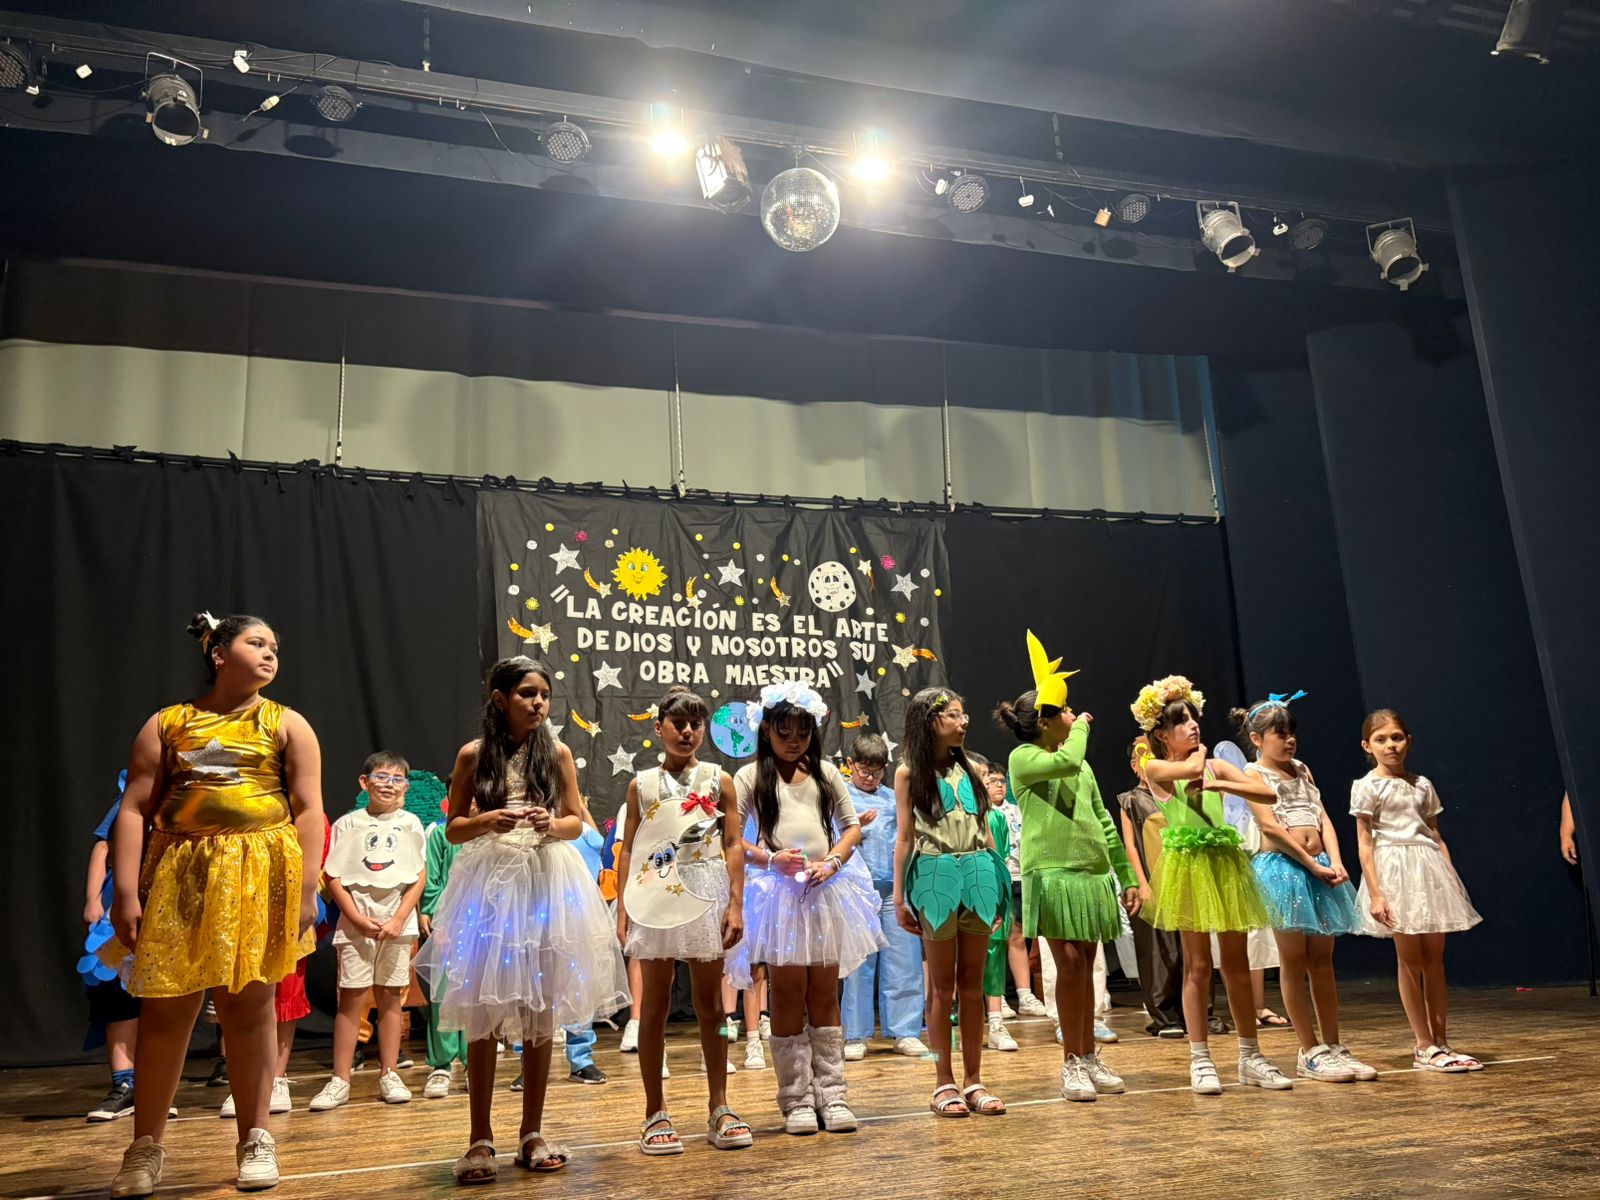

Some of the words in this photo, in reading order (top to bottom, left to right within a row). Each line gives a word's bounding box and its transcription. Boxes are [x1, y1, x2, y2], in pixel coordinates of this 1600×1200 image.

[611, 601, 737, 631] CREACIÓN
[752, 612, 781, 632] ES
[793, 614, 823, 636] EL
[836, 618, 889, 643] ARTE
[577, 627, 610, 652] DE
[614, 630, 673, 653] DIOS
[687, 635, 702, 657] Y
[711, 635, 838, 660] NOSOTROS
[849, 641, 876, 663] SU
[639, 660, 710, 684] OBRA
